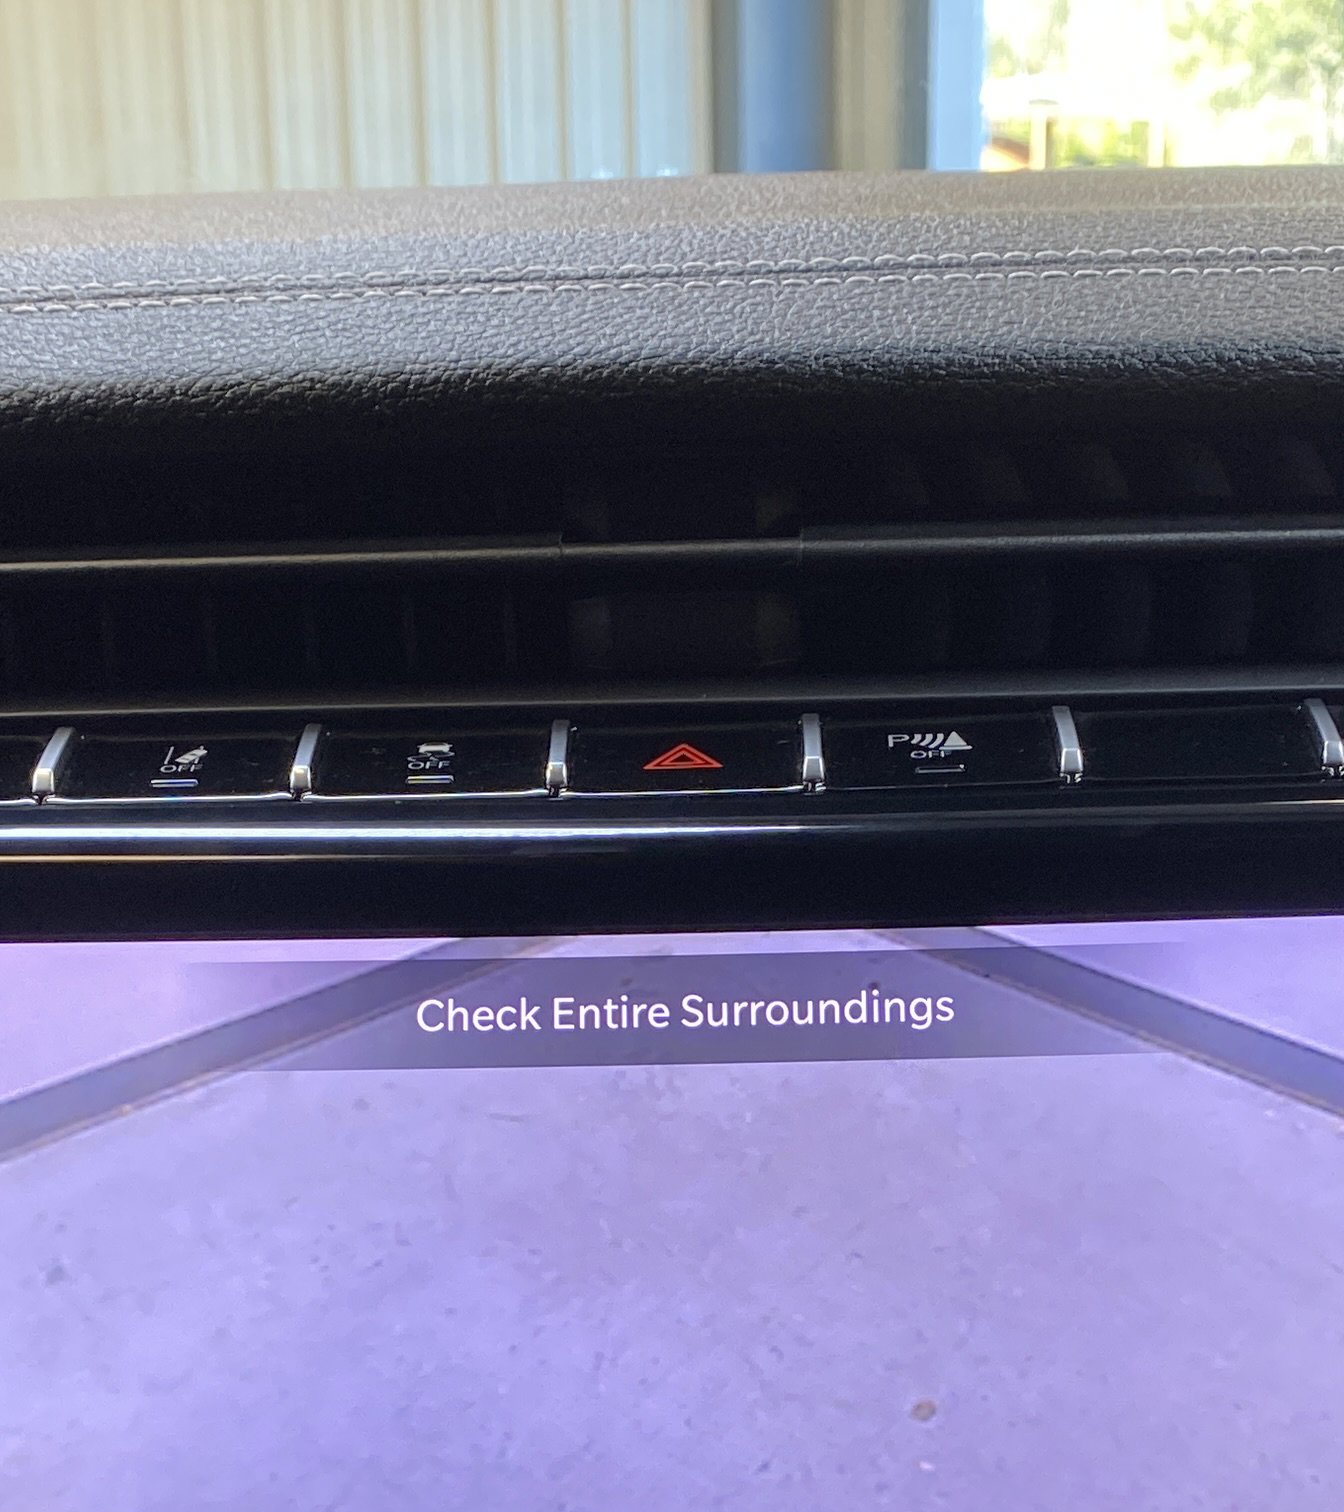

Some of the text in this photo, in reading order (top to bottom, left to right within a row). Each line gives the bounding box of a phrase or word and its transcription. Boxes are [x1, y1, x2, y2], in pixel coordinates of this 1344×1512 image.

[910, 749, 952, 759] OFF
[159, 764, 203, 773] OFF
[407, 761, 450, 769] OFF
[415, 989, 955, 1033] Check Entire Surroundings
